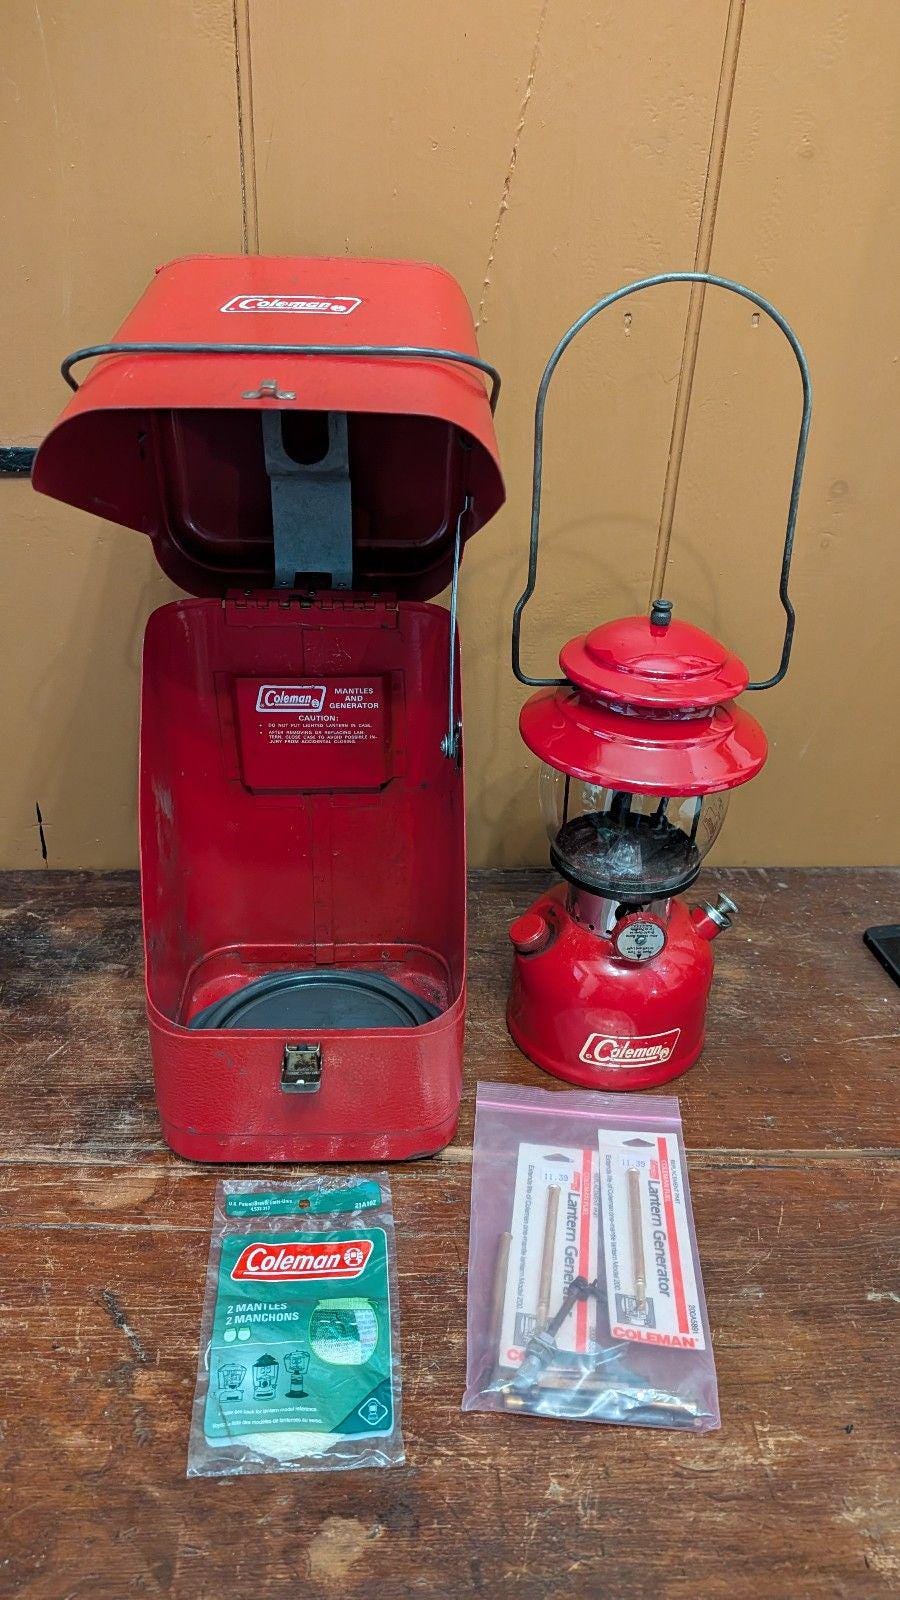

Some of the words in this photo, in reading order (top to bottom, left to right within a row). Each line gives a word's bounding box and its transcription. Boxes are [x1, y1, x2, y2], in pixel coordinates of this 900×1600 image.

[238, 299, 331, 310] Coleman
[265, 690, 312, 707] Coleman
[334, 687, 374, 695] MANTLES
[298, 714, 339, 722] CAUTION:
[593, 1038, 662, 1062] Coleman
[544, 1172, 569, 1182] 11.39
[648, 1180, 662, 1227] Lantern
[566, 1192, 581, 1242] Lantern
[246, 1247, 340, 1272] Coleman
[653, 1229, 670, 1298] Generator
[226, 1305, 234, 1315] 2
[235, 1302, 288, 1313] MANTLES
[225, 1316, 233, 1326] 2
[234, 1311, 300, 1324] MANCHONS
[612, 1326, 696, 1348] COLEMAN
